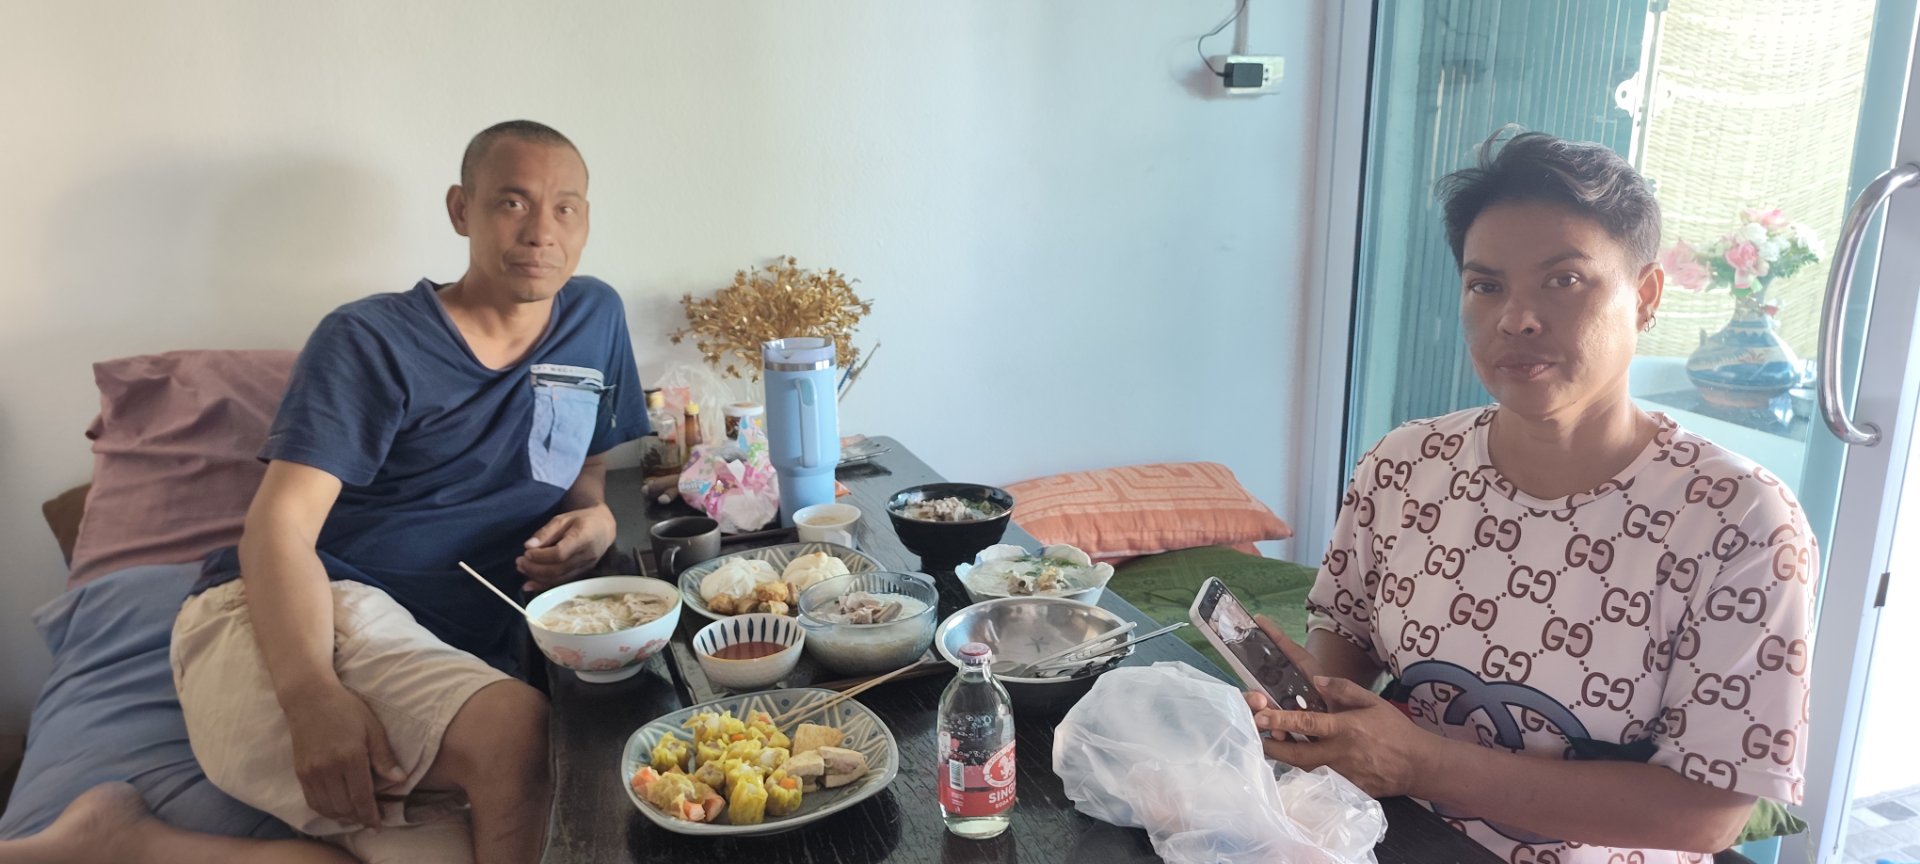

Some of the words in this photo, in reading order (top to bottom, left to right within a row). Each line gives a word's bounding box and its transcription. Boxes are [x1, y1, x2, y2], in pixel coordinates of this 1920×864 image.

[1421, 432, 1464, 461] GG
[1374, 458, 1412, 491] GG
[1685, 475, 1739, 509] GG
[1401, 499, 1441, 534] GG
[1474, 515, 1521, 552] GG
[1622, 504, 1675, 543] GG
[1424, 544, 1465, 580] GG
[1565, 534, 1615, 575] GG
[1656, 551, 1699, 593] GG
[1772, 543, 1810, 585] GG
[1382, 572, 1415, 608] GG
[1507, 565, 1557, 604] GG
[1449, 593, 1498, 631] GG
[1601, 587, 1651, 627] GG
[1705, 586, 1767, 624] GG
[1400, 620, 1439, 657] GG
[1541, 616, 1593, 658] GG
[1757, 635, 1807, 676] GG
[1481, 645, 1532, 684] GG
[1581, 672, 1635, 711] GG
[1691, 673, 1751, 710] GG
[1742, 723, 1797, 766] GG
[1681, 752, 1737, 791] GG
